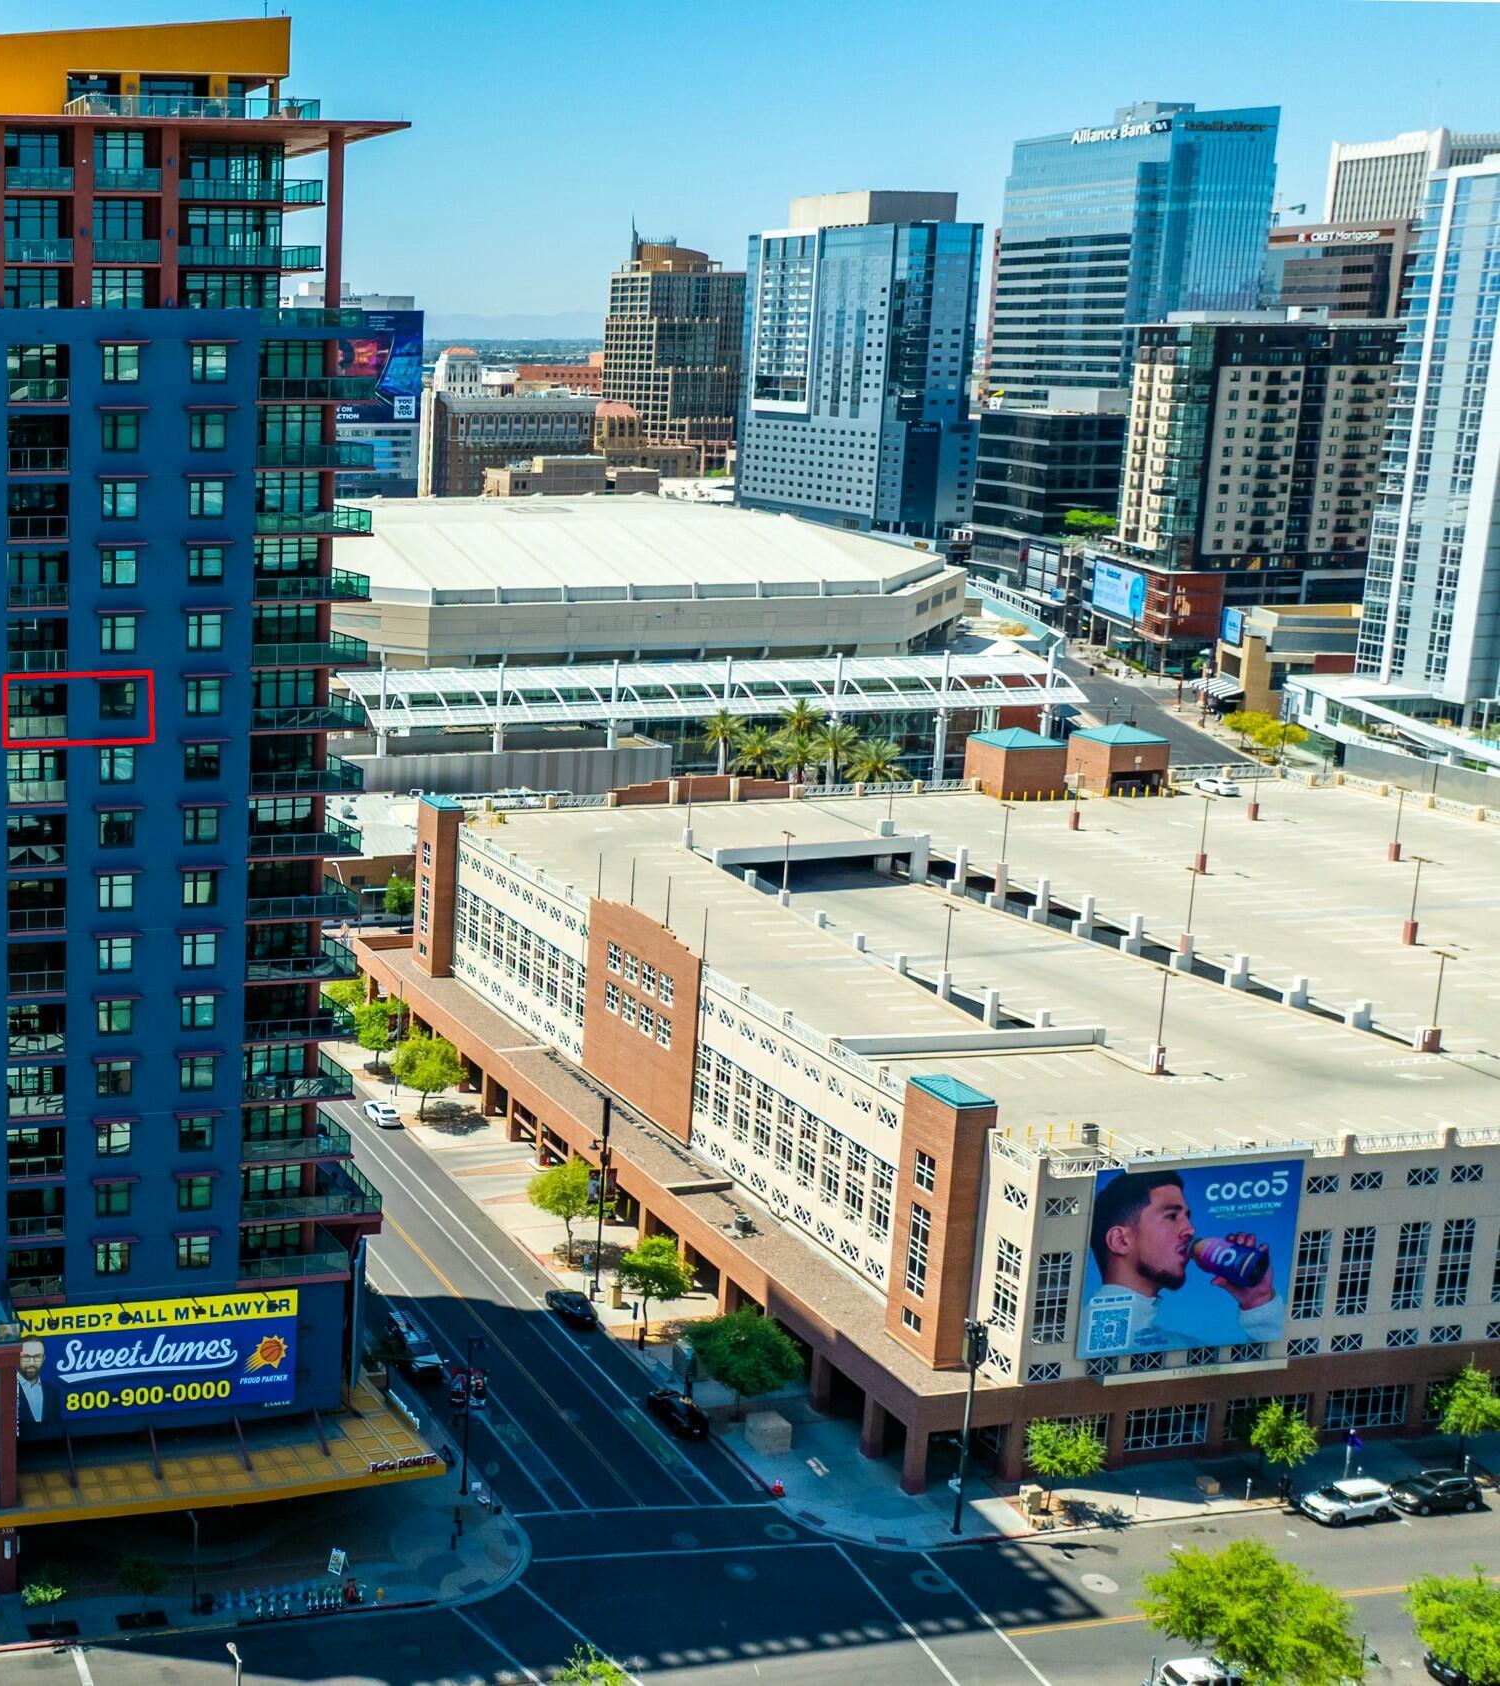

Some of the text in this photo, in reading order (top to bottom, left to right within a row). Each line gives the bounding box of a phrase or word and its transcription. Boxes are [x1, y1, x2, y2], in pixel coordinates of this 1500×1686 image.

[1071, 129, 1117, 145] Alliance
[1120, 122, 1152, 139] Bank
[1335, 230, 1380, 243] Mortgage
[989, 396, 1004, 411] EY
[19, 1312, 113, 1333] NJURED?
[239, 1373, 288, 1385] PROUD PARTNER
[66, 1380, 231, 1412] 800-900-0000
